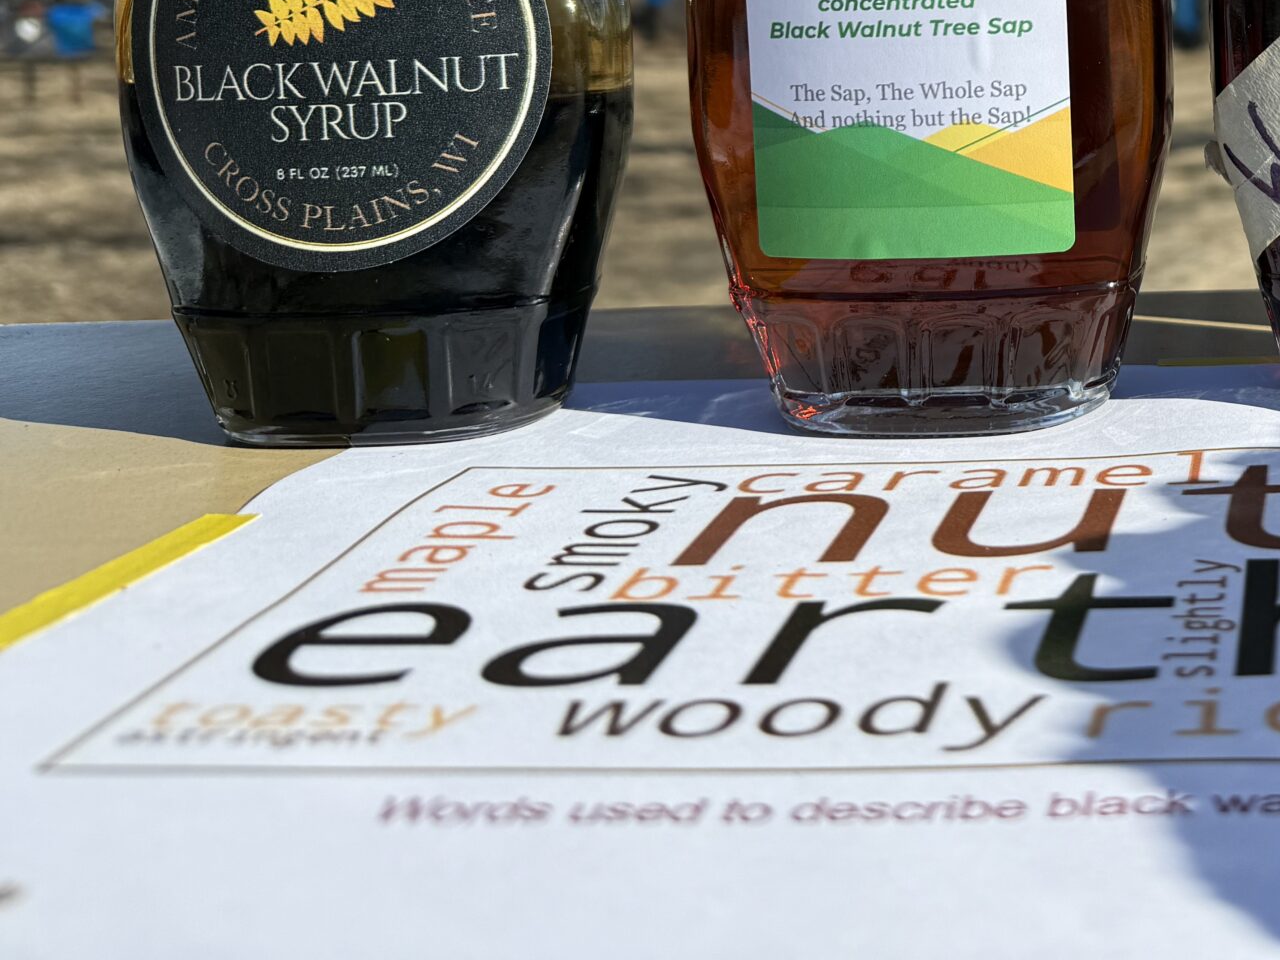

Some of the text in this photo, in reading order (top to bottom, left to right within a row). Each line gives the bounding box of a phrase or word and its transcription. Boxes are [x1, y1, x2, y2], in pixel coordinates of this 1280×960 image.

[770, 17, 1033, 39] Black Walnut Tree Sap
[174, 53, 519, 102] BLACK WALNUT
[790, 80, 1027, 106] The Sap, The Whole Sap
[271, 102, 407, 143] SYRUP
[789, 105, 1032, 131] And nothing but the Sap!
[204, 132, 480, 232] CROSS PLAINS, WI
[277, 163, 399, 181] 8 FL OZ (237 ML)
[737, 450, 1220, 493] caramel
[359, 480, 557, 594] maple
[524, 473, 729, 592] smoky
[610, 564, 1054, 600] bitter
[1163, 558, 1242, 678] slightly
[148, 700, 478, 736] toasty
[555, 682, 1047, 752] woody
[379, 795, 555, 825] Words
[568, 797, 707, 823] used
[723, 799, 770, 822] to
[791, 792, 1027, 823] describe
[1046, 789, 1195, 819] black
